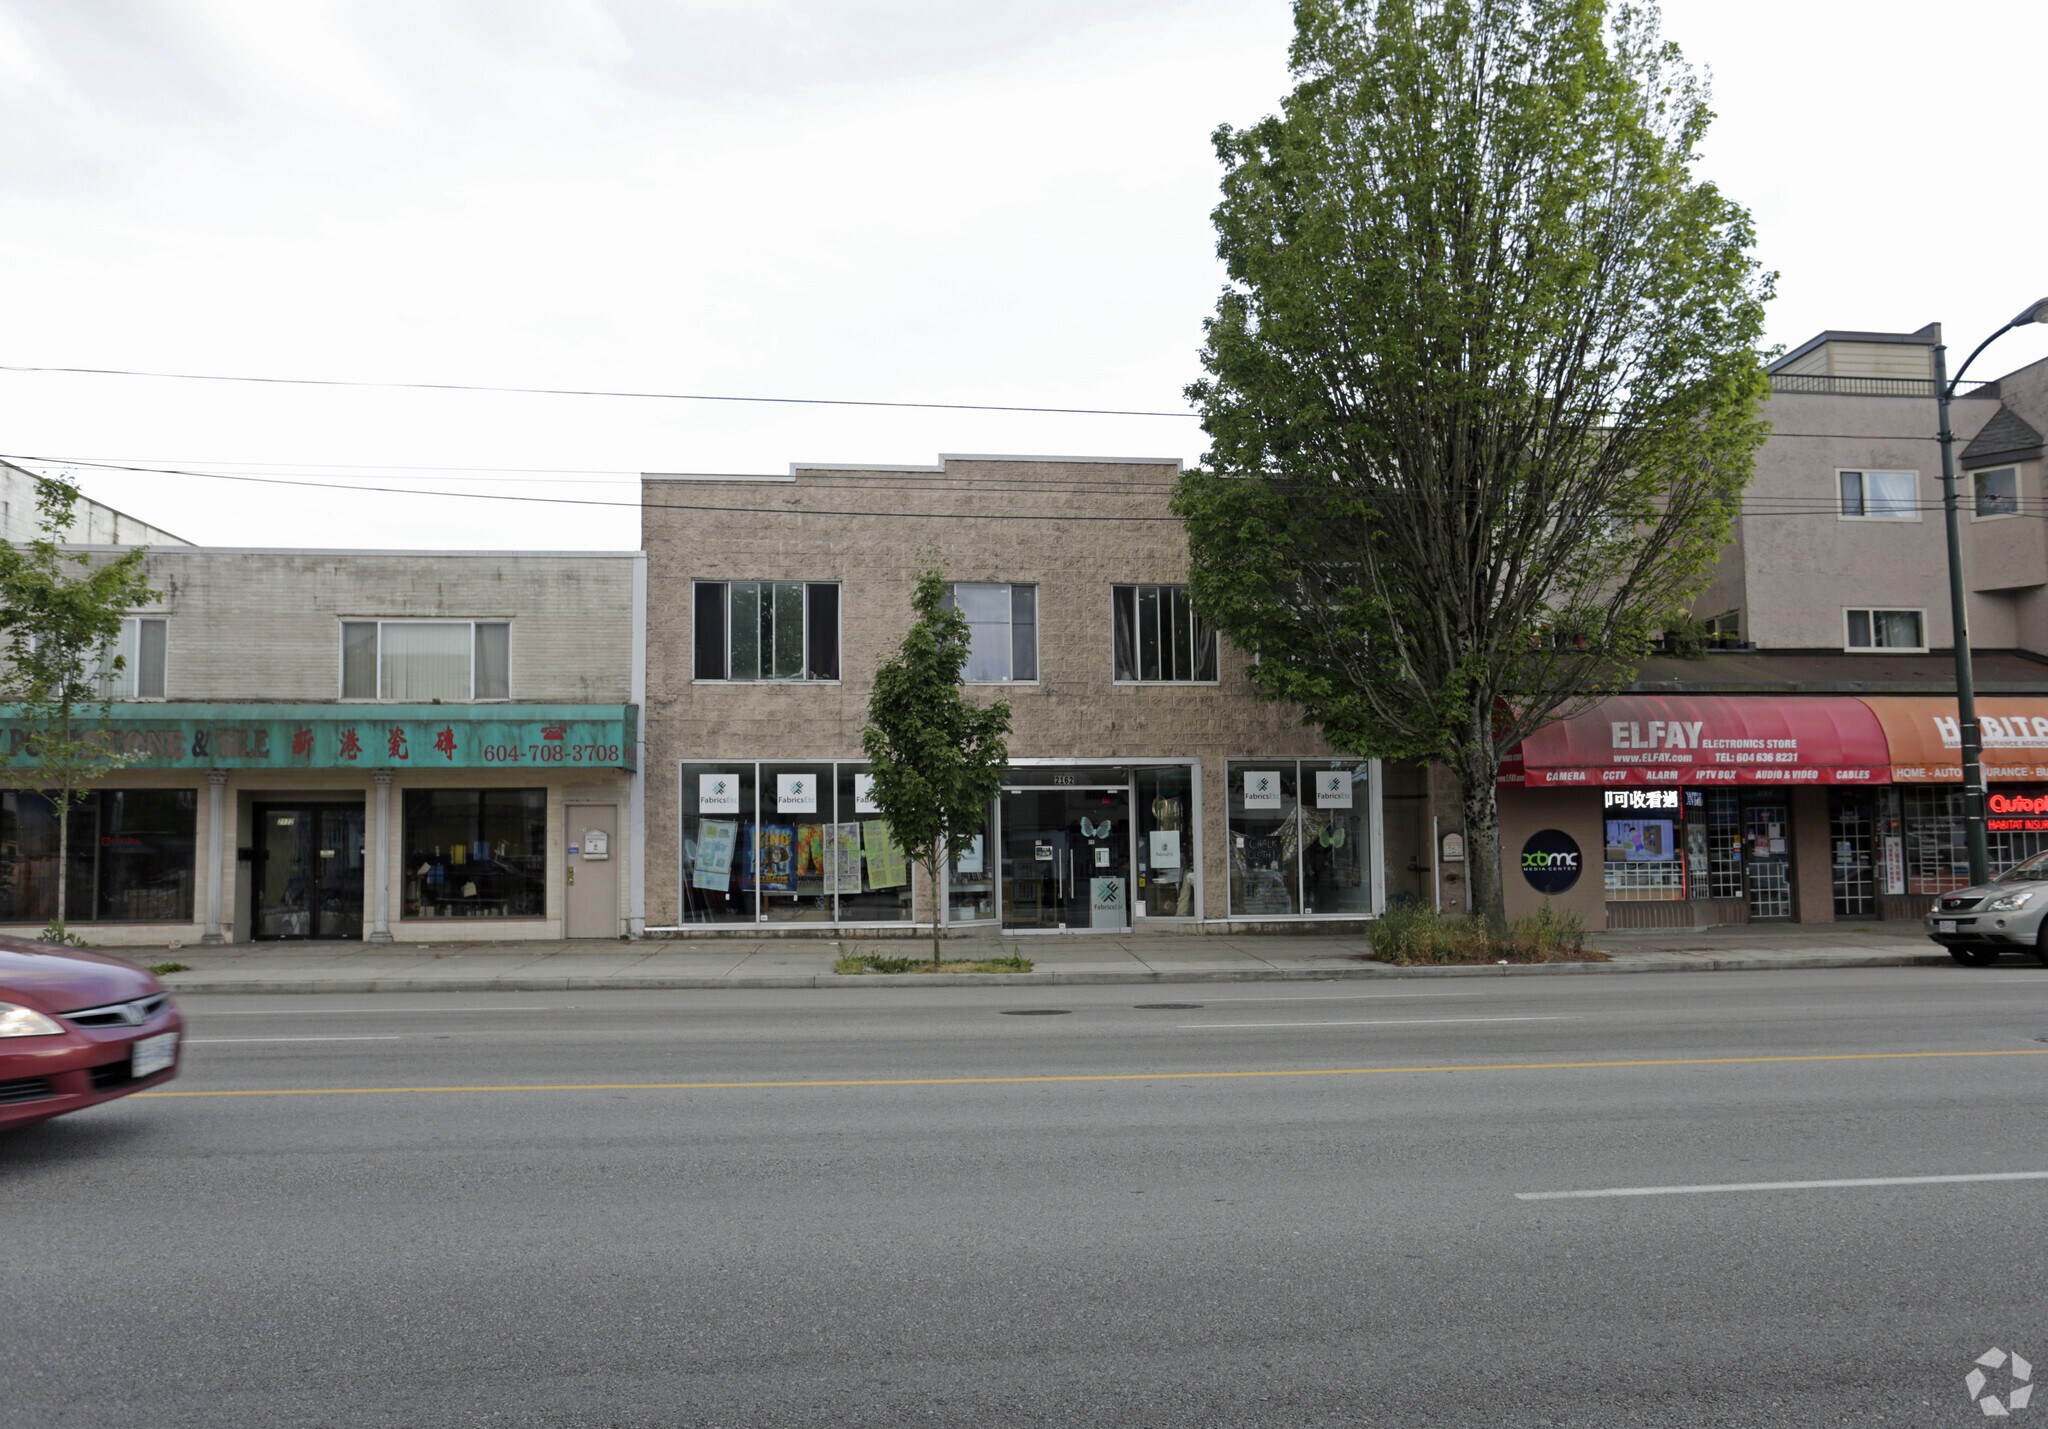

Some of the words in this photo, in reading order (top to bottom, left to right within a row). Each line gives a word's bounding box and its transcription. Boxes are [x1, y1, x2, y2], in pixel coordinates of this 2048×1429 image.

[1933, 716, 2048, 743] HBITA
[1611, 721, 1703, 749] ELFAY
[9, 728, 79, 758] POT
[191, 729, 209, 758] &
[215, 728, 271, 758] TILE
[1702, 739, 1765, 749] ELECTRONICS
[1766, 739, 1797, 749] STORE
[483, 744, 619, 762] 604-708-3708
[1613, 752, 1693, 763] www.ELFAY.com
[1715, 752, 1735, 763] TEL:
[1736, 752, 1755, 763] 604
[1756, 752, 1774, 763] 636
[1775, 752, 1798, 763] 8231
[1545, 771, 1586, 782] CAMERA
[1602, 770, 1627, 780] CCTV
[1646, 770, 1679, 780] ALARM
[1696, 770, 1717, 780] IPTV
[1718, 770, 1737, 780] BOX
[1755, 770, 1782, 780] AUDIO
[1783, 770, 1790, 779] &
[1792, 769, 1819, 779] VIDEO
[1836, 770, 1871, 780] CABLES
[1896, 768, 1926, 777] HOME
[1934, 768, 1962, 777] AUTO
[1986, 768, 2027, 777] URANCE
[1054, 776, 1075, 785] 2162
[700, 796, 737, 804] FabricsEtc
[778, 796, 815, 804] FabricsEtc
[1245, 792, 1280, 800] FabricsEtc
[1317, 792, 1351, 800] FabricsEtc
[1987, 819, 2024, 831] HABITAT
[1248, 839, 1278, 849] CHALK
[1521, 850, 1579, 867] xbmc
